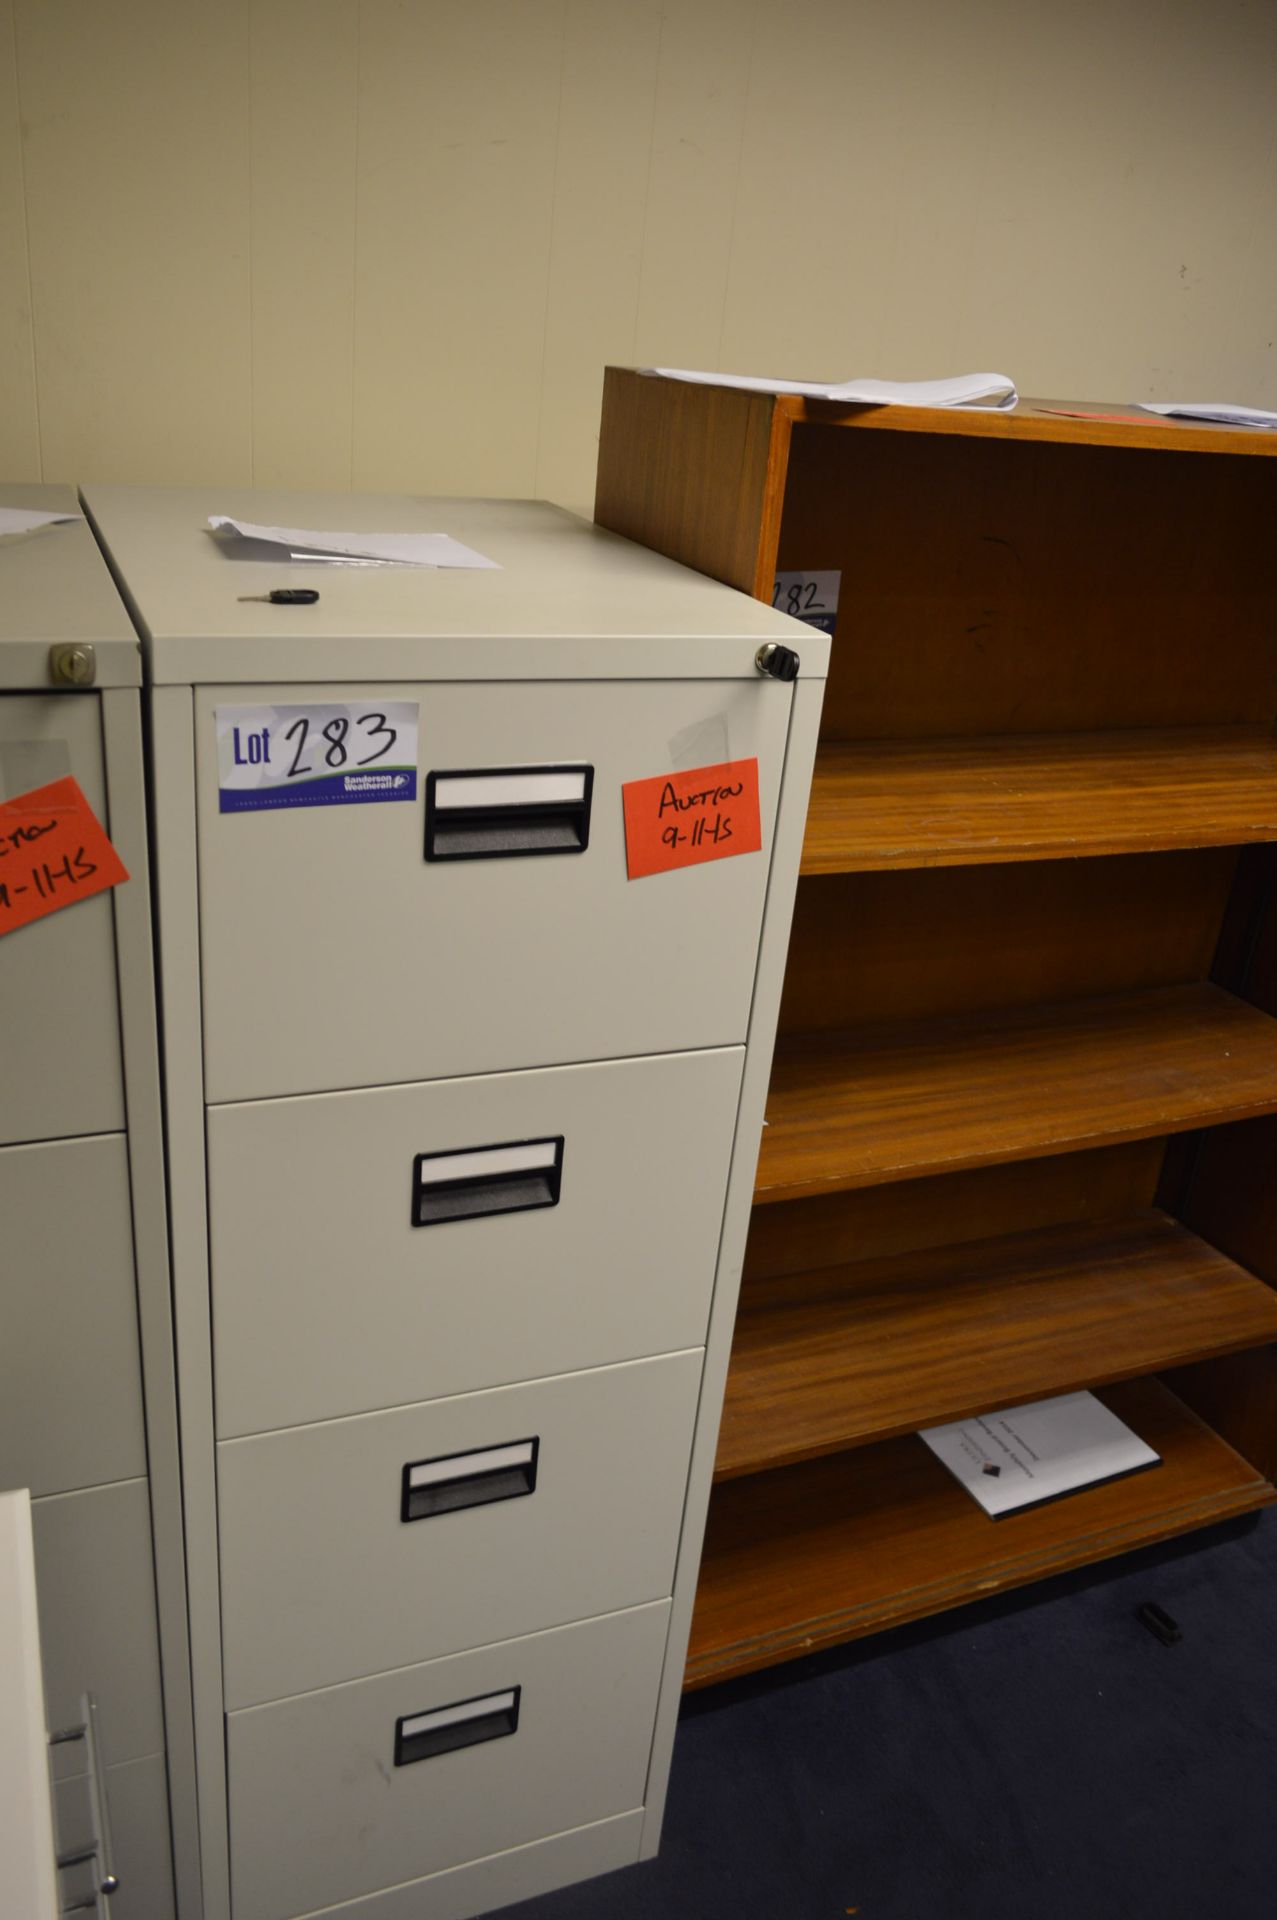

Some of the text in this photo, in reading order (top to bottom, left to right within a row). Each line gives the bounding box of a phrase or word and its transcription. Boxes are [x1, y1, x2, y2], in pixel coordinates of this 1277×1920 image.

[233, 713, 397, 777] Lot 283
[344, 775, 392, 784] Sanderson
[344, 782, 392, 792] Weatherall
